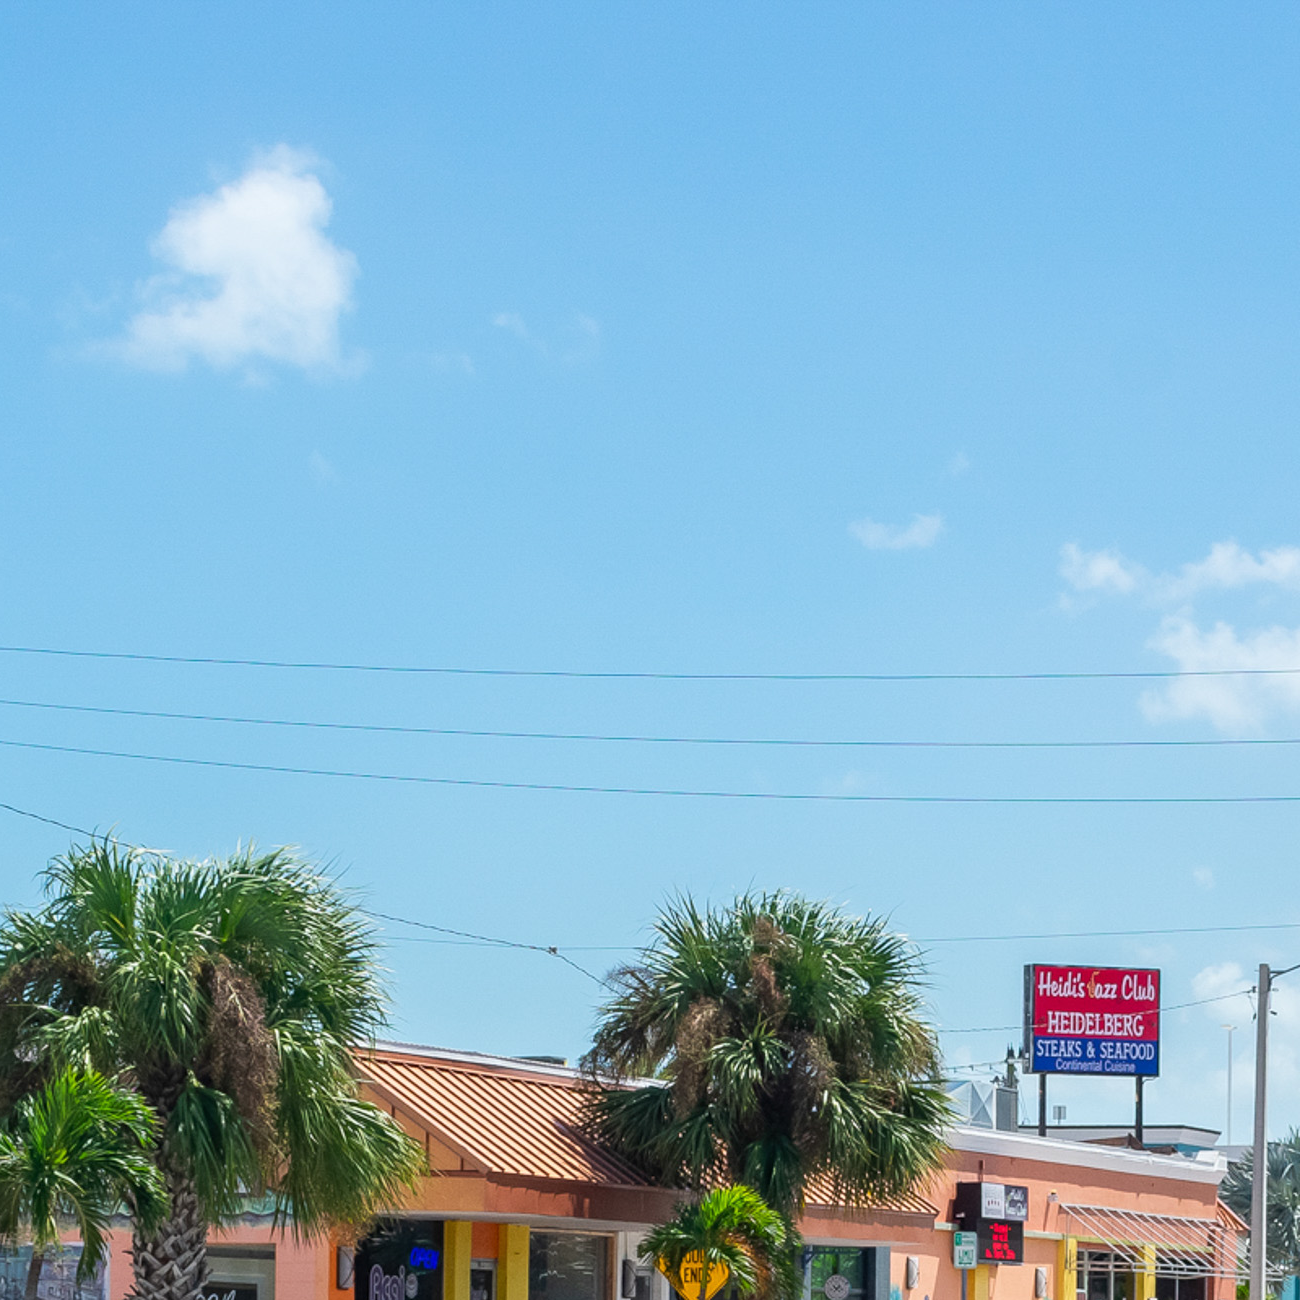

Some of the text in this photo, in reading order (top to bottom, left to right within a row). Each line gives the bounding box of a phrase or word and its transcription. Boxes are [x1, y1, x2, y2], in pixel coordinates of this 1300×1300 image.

[1038, 971, 1086, 998] Heidi's
[1122, 974, 1155, 1001] Club
[1047, 1011, 1145, 1037] HEIDELBERG
[1036, 1039, 1155, 1060] STEAKS & SEAFOOD
[1055, 1058, 1136, 1073] Continental Cuisine
[410, 1246, 440, 1270] OPEN
